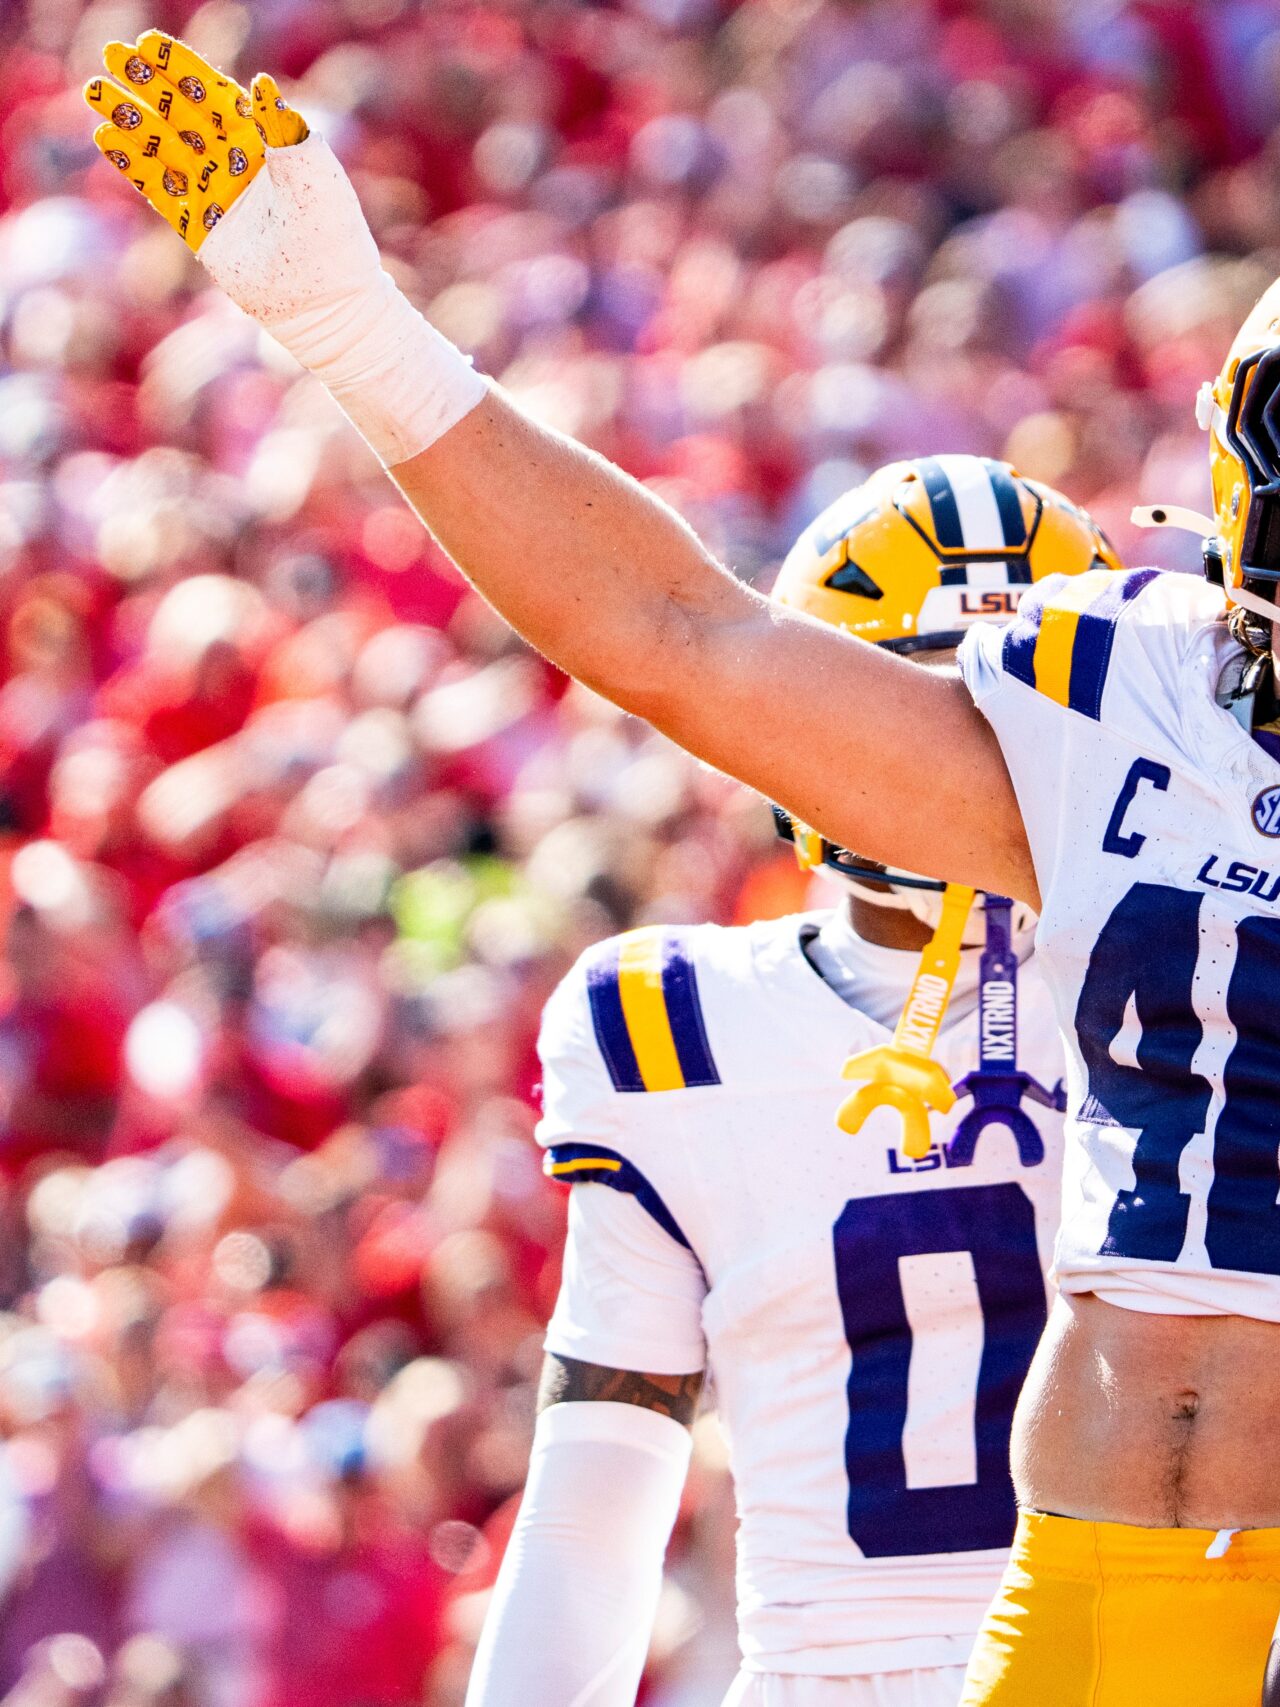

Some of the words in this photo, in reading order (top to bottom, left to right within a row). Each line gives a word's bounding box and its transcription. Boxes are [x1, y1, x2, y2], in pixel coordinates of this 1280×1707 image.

[197, 160, 218, 193] LSU
[1102, 757, 1171, 858] C
[901, 973, 948, 1052] NXTRND
[982, 980, 1014, 1061] NXTRND
[833, 1182, 1048, 1559] 0
